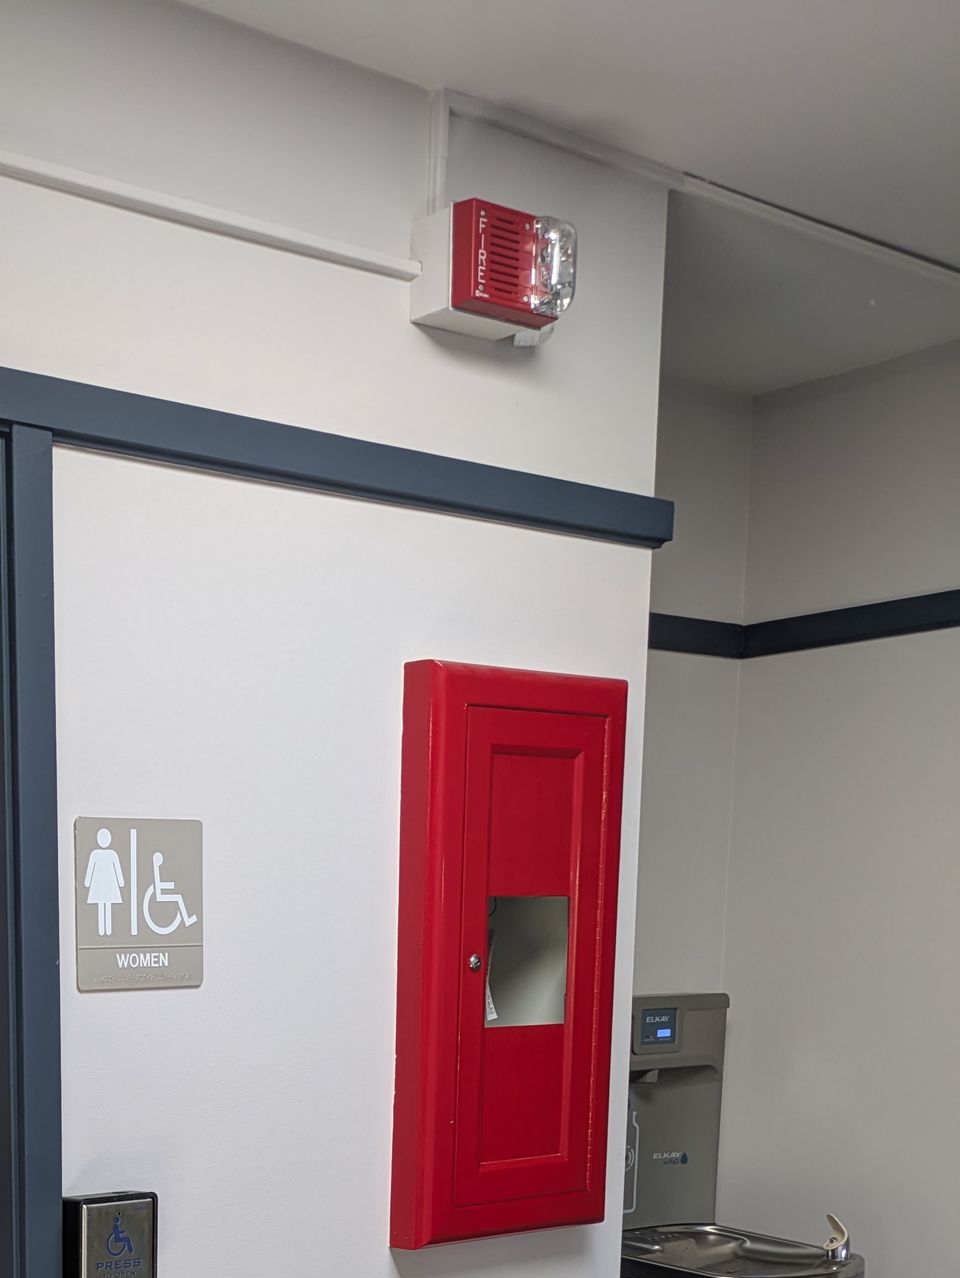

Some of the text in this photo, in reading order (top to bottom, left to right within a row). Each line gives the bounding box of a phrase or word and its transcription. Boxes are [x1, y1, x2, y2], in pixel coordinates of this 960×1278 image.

[478, 217, 488, 284] FIRE
[116, 952, 169, 968] WOMEN
[646, 1015, 670, 1023] ELKAY
[653, 1151, 682, 1159] ELKAY
[96, 1257, 141, 1272] PRESS
